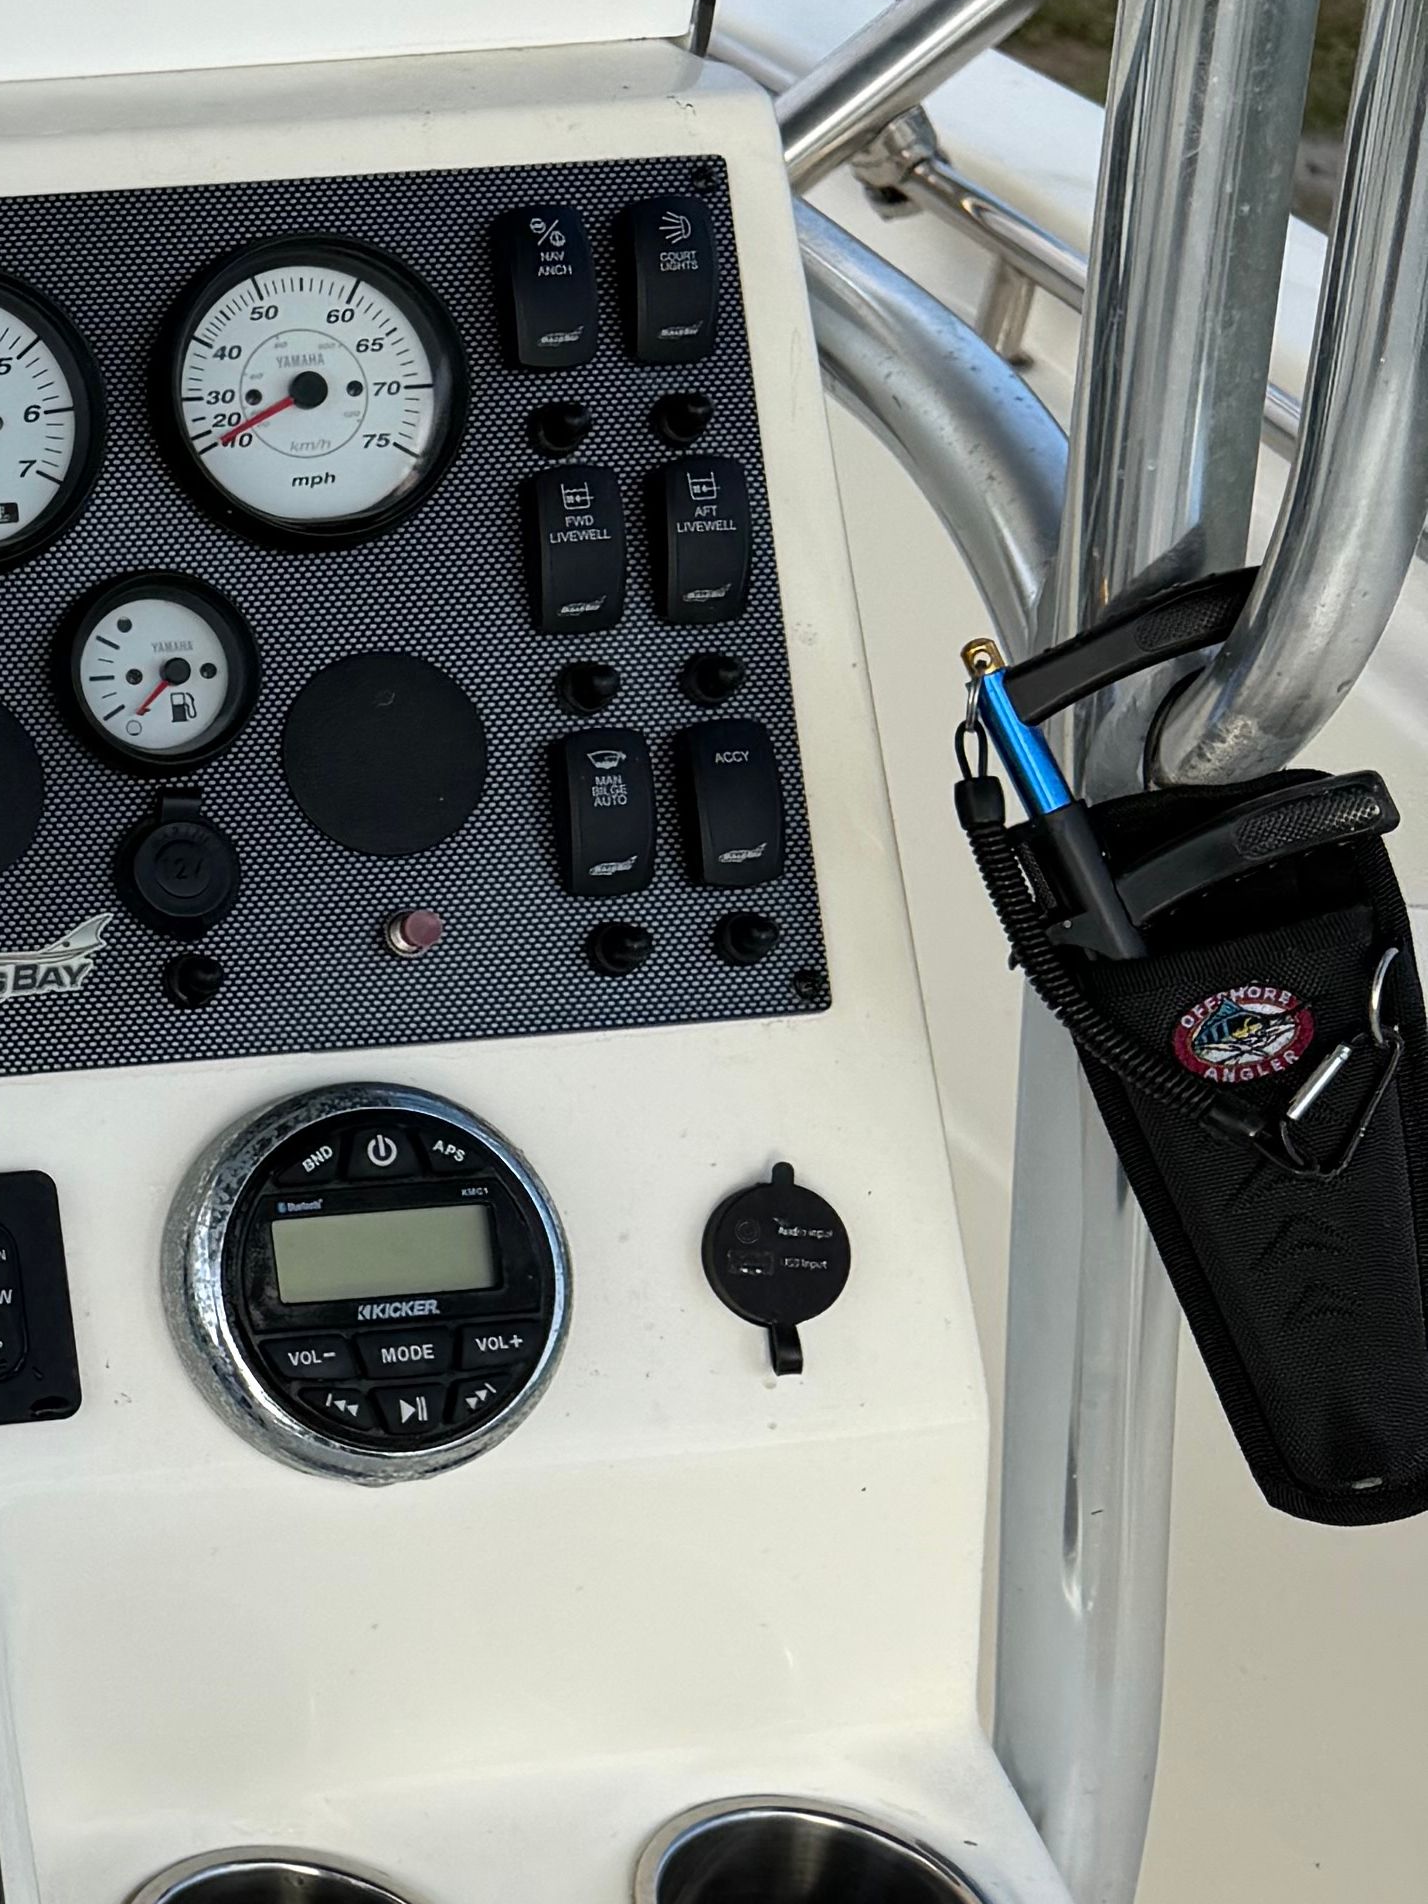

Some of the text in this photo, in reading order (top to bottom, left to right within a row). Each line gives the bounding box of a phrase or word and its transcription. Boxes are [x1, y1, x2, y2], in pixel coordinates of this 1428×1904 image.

[541, 252, 565, 262] NAV
[660, 251, 696, 262] COURT
[538, 265, 572, 277] ANCH
[660, 261, 698, 271] LIGHTS
[250, 305, 279, 321] 50
[326, 308, 355, 324] 60
[356, 337, 384, 353] 65
[213, 346, 242, 361] 40
[276, 353, 325, 368] YAMAHA
[373, 381, 401, 396] 70
[206, 390, 236, 405] 30
[23, 405, 41, 423] 6
[212, 412, 242, 428] 20
[290, 439, 331, 452] km/h
[362, 433, 391, 449] 75
[18, 460, 37, 478] 7
[292, 472, 336, 488] mph
[695, 505, 718, 517] AFT
[565, 514, 594, 527] FWD
[677, 519, 736, 533] LIVEWELL
[550, 529, 612, 544] LIVEWELL
[151, 641, 193, 653] YAMAHA
[715, 751, 750, 764] ACCY
[595, 775, 622, 785] MAN
[592, 784, 628, 797] BILGE
[594, 795, 628, 807] AUTO
[1204, 1050, 1300, 1083] ANGLER
[302, 1145, 334, 1173] BND
[433, 1140, 465, 1163] APS
[372, 1300, 440, 1321] KICKER
[475, 1334, 524, 1353] VOL+
[381, 1344, 435, 1364] MODE
